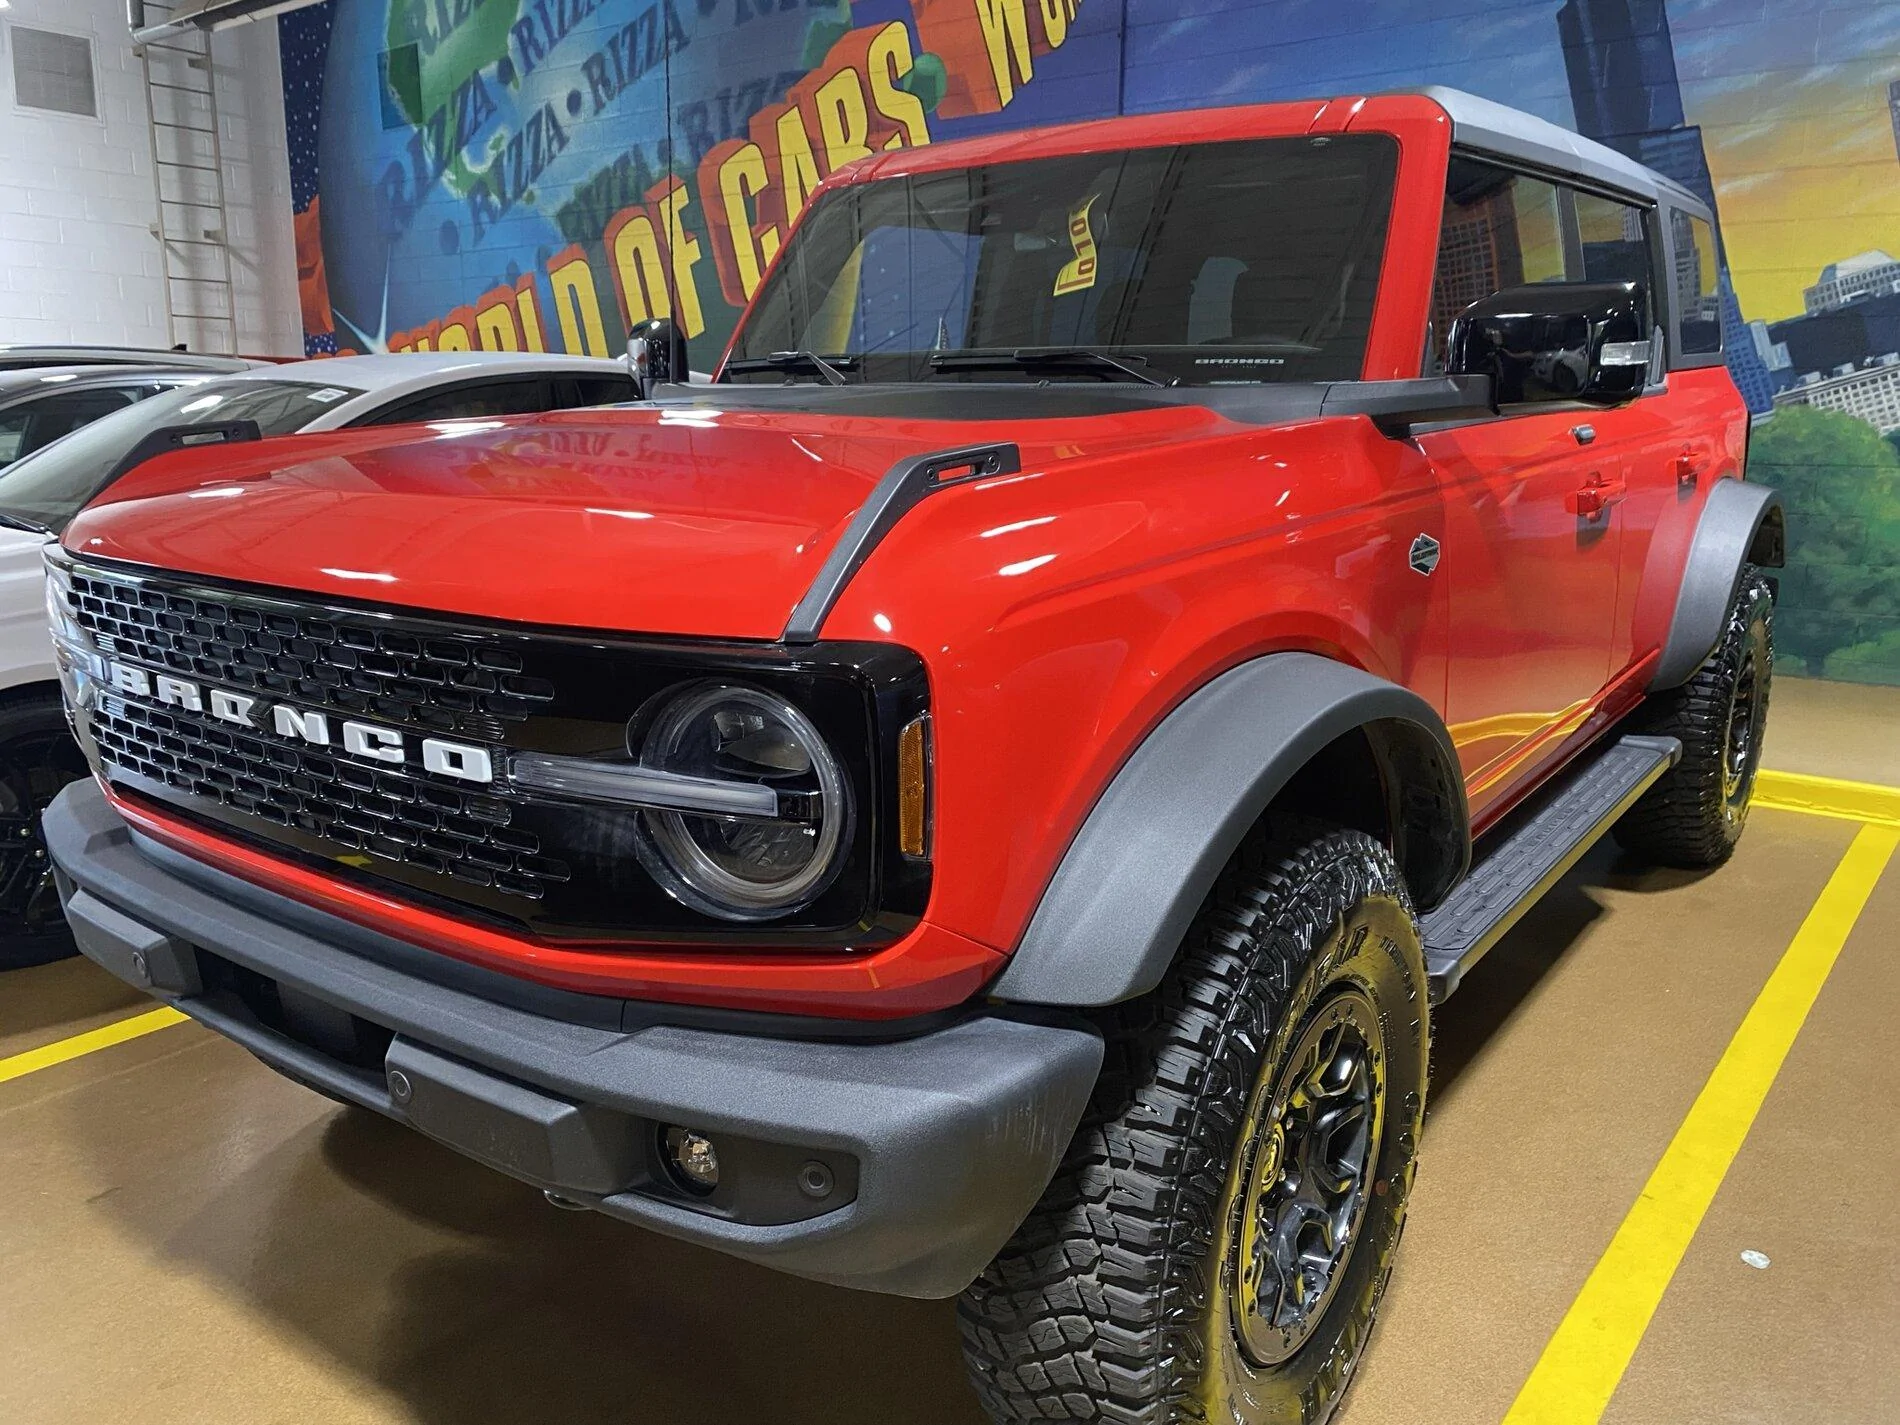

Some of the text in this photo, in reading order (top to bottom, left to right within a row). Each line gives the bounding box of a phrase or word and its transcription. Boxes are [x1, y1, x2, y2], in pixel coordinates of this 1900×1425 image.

[467, 0, 691, 247] RIZZA RIZZA
[718, 20, 933, 304] CARS
[108, 661, 494, 784] BRONCO
